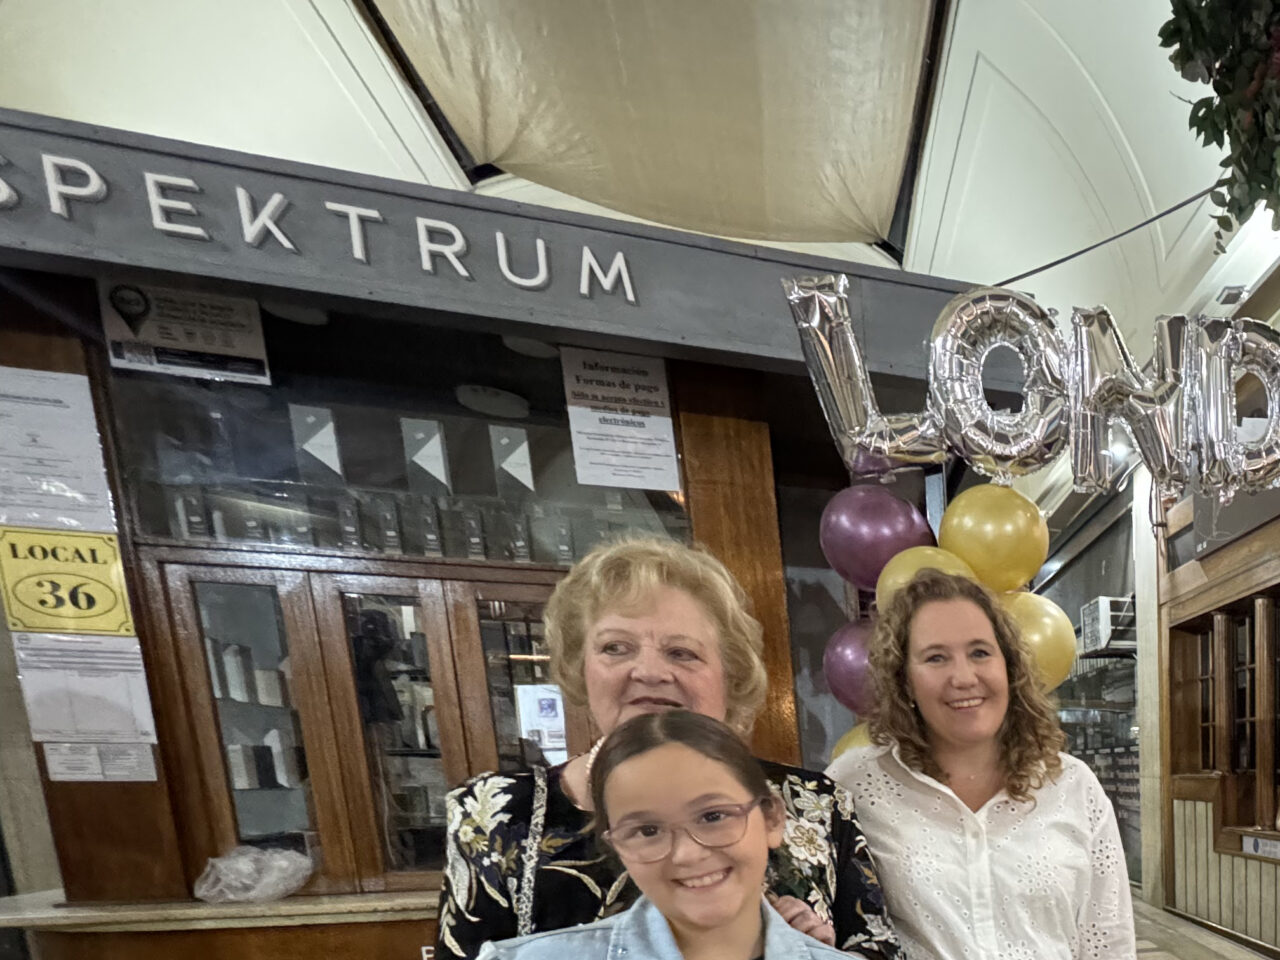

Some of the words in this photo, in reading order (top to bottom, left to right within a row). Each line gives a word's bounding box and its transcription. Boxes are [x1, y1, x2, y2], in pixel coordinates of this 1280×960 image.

[576, 375, 617, 389] Formas
[619, 380, 631, 390] de
[634, 383, 660, 393] pago
[8, 543, 108, 565] LOCAL
[35, 578, 97, 612] 36
